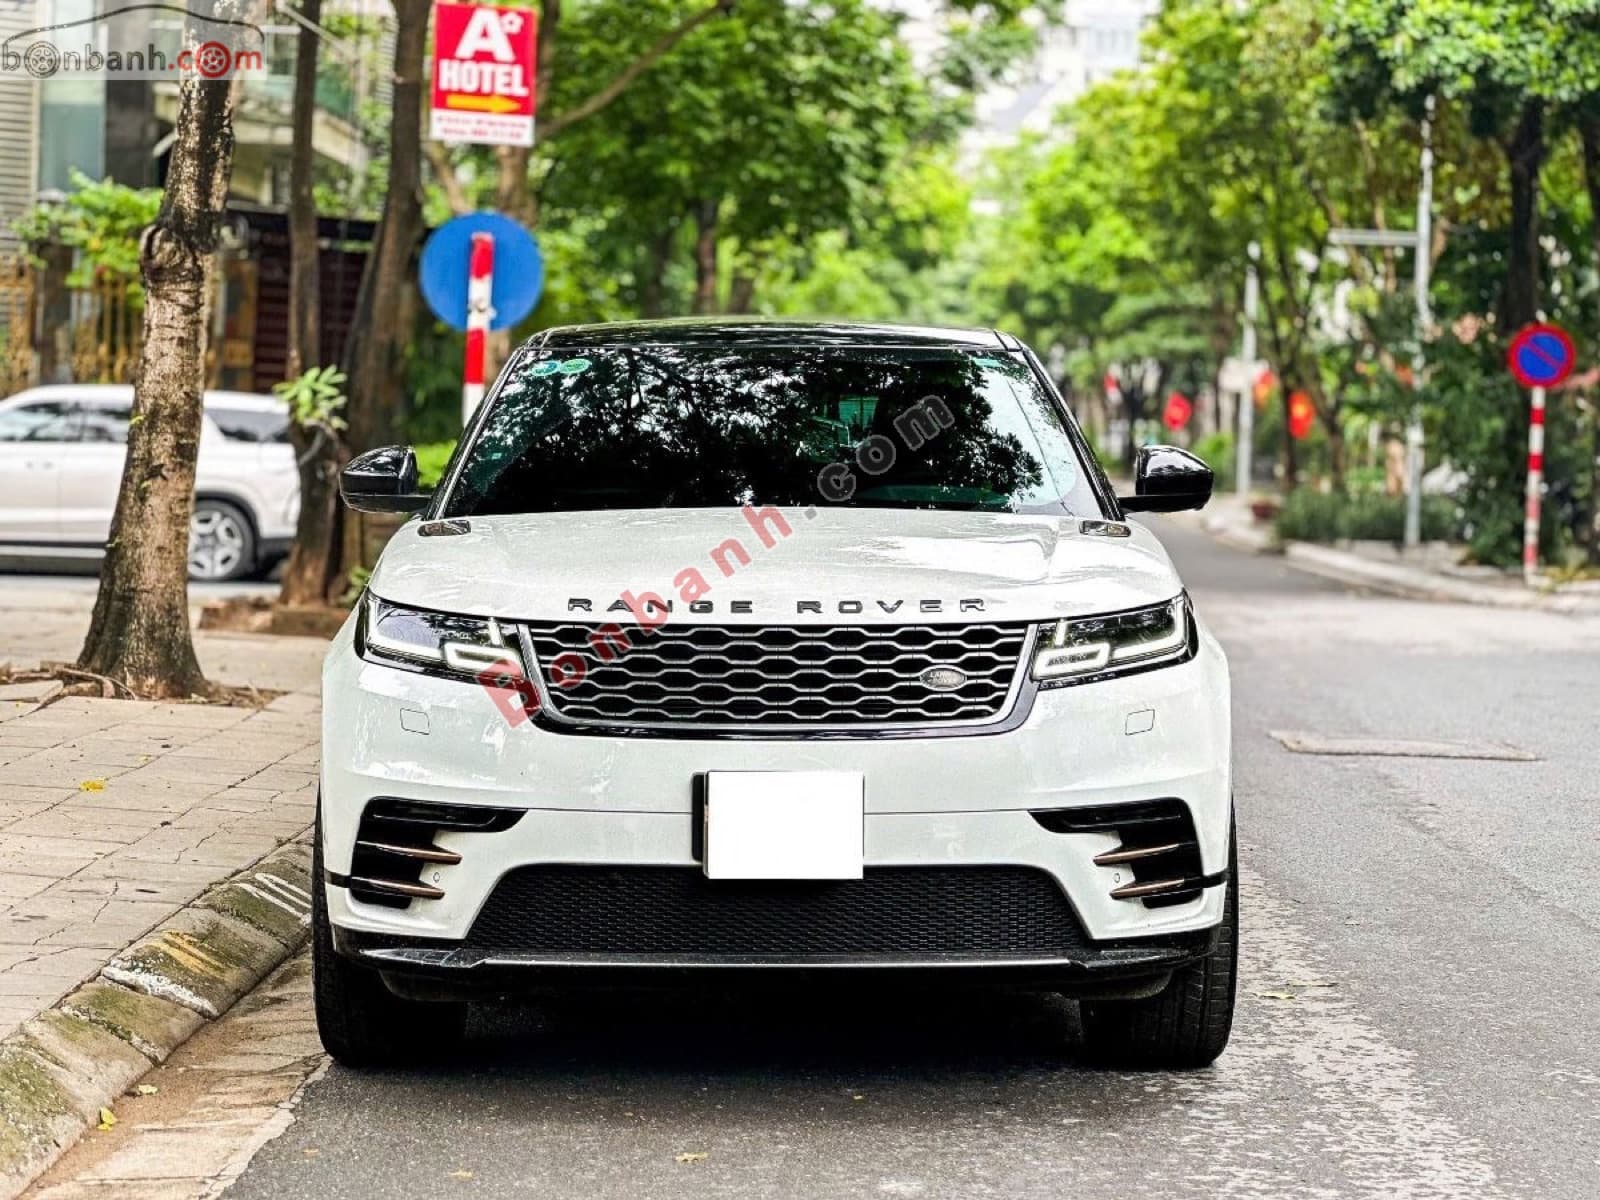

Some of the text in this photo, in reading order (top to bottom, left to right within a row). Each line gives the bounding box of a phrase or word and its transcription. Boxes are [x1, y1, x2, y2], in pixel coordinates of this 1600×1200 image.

[438, 58, 529, 97] HOTEL
[567, 597, 986, 614] RANGE ROVER
